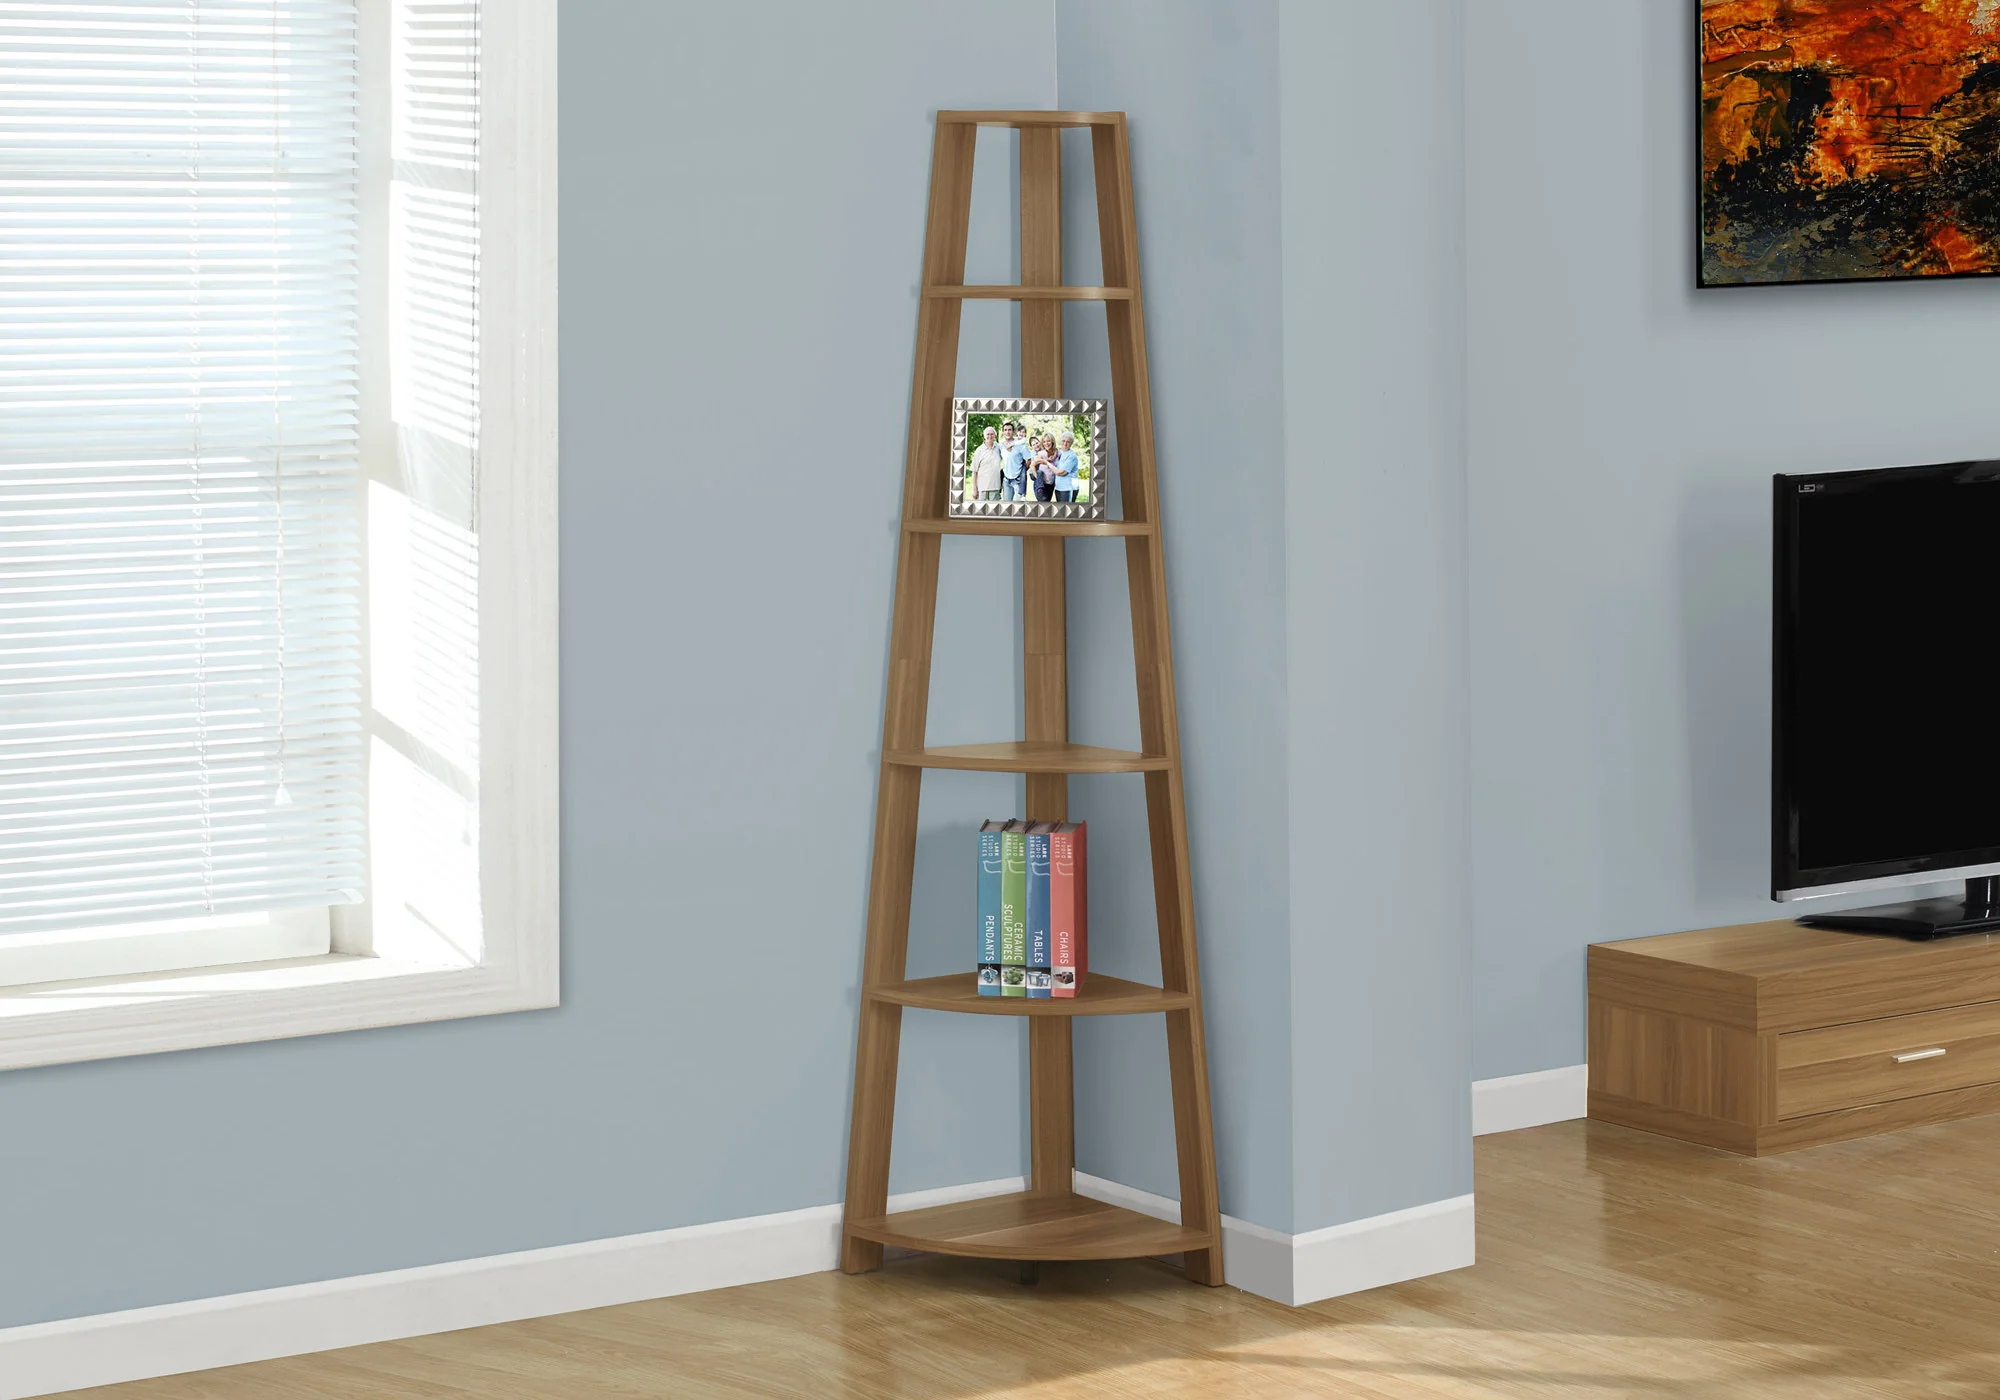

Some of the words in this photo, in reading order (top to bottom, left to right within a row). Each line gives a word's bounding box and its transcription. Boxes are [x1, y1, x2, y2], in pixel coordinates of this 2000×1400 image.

[985, 915, 995, 961] PENDANTS
[1003, 904, 1013, 961] SCULPTURES
[1013, 922, 1023, 961] CERAMIC
[1034, 930, 1043, 964] TABLES
[1059, 931, 1069, 965] CHAIRS
